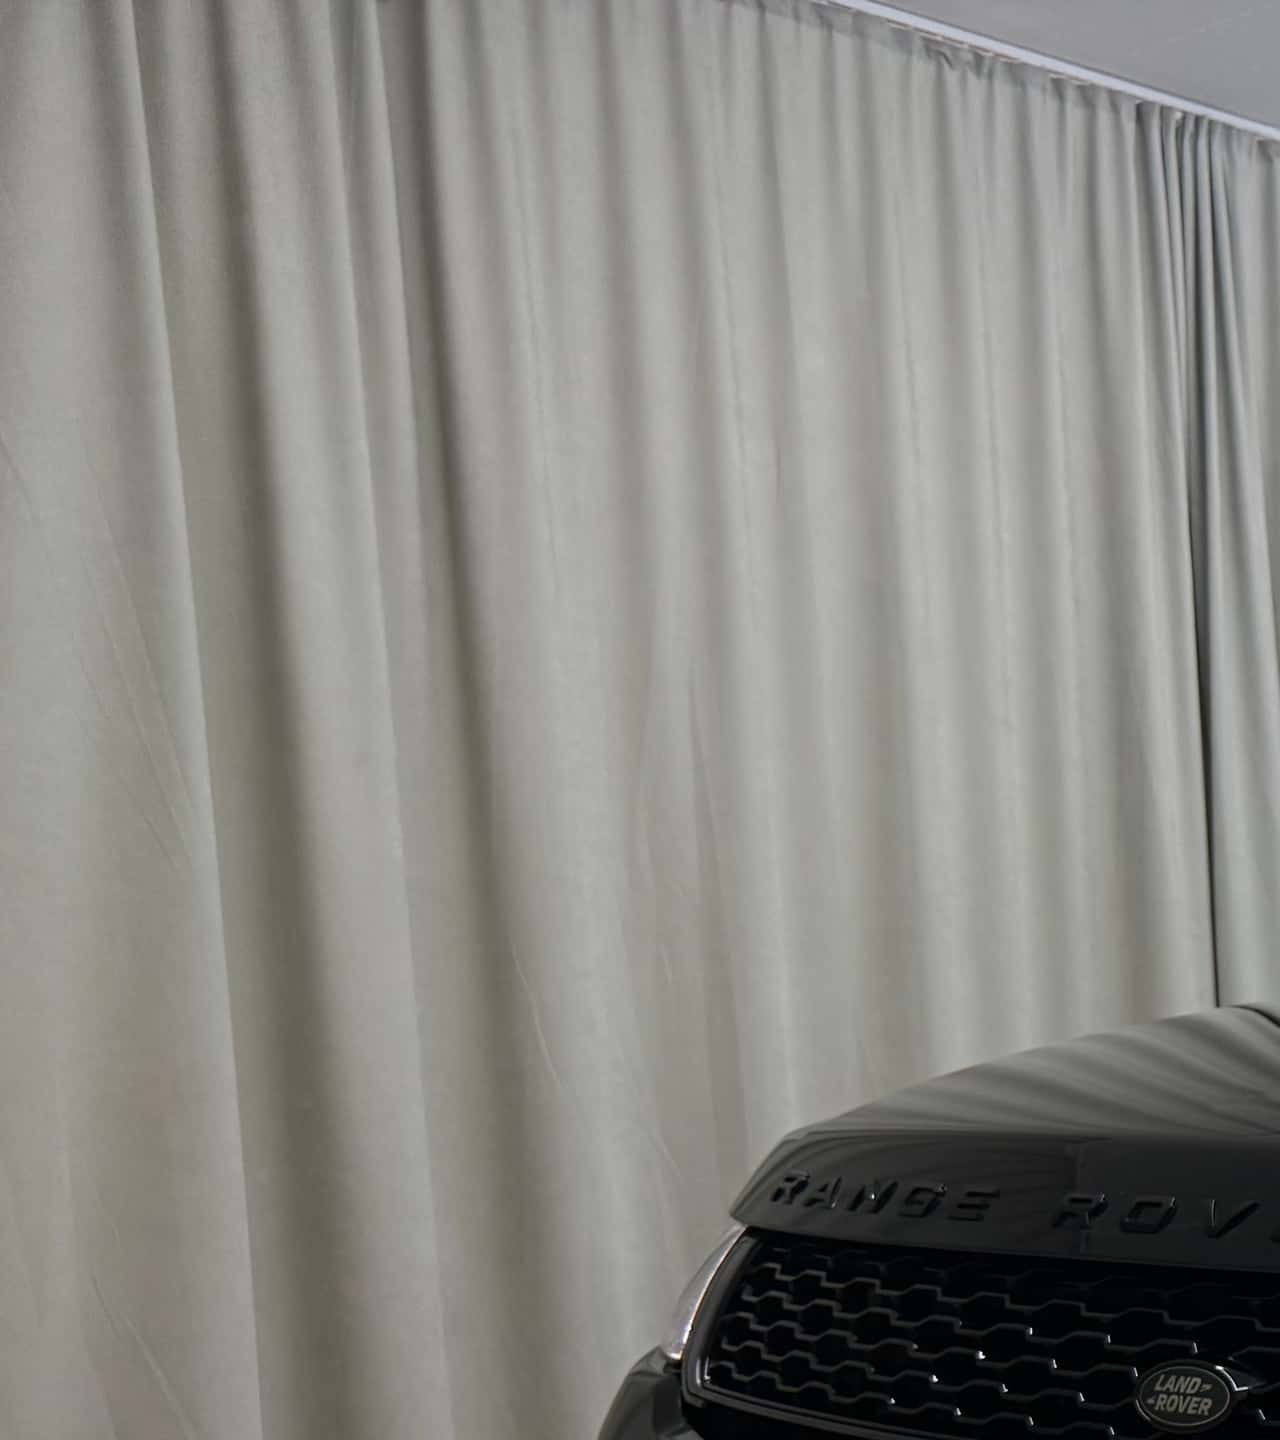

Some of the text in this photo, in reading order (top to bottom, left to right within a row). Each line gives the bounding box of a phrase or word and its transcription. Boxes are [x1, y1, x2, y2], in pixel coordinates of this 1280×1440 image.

[772, 1171, 1001, 1222] RANGE
[1153, 1373, 1203, 1395] LAND
[1154, 1393, 1214, 1416] ROVER
